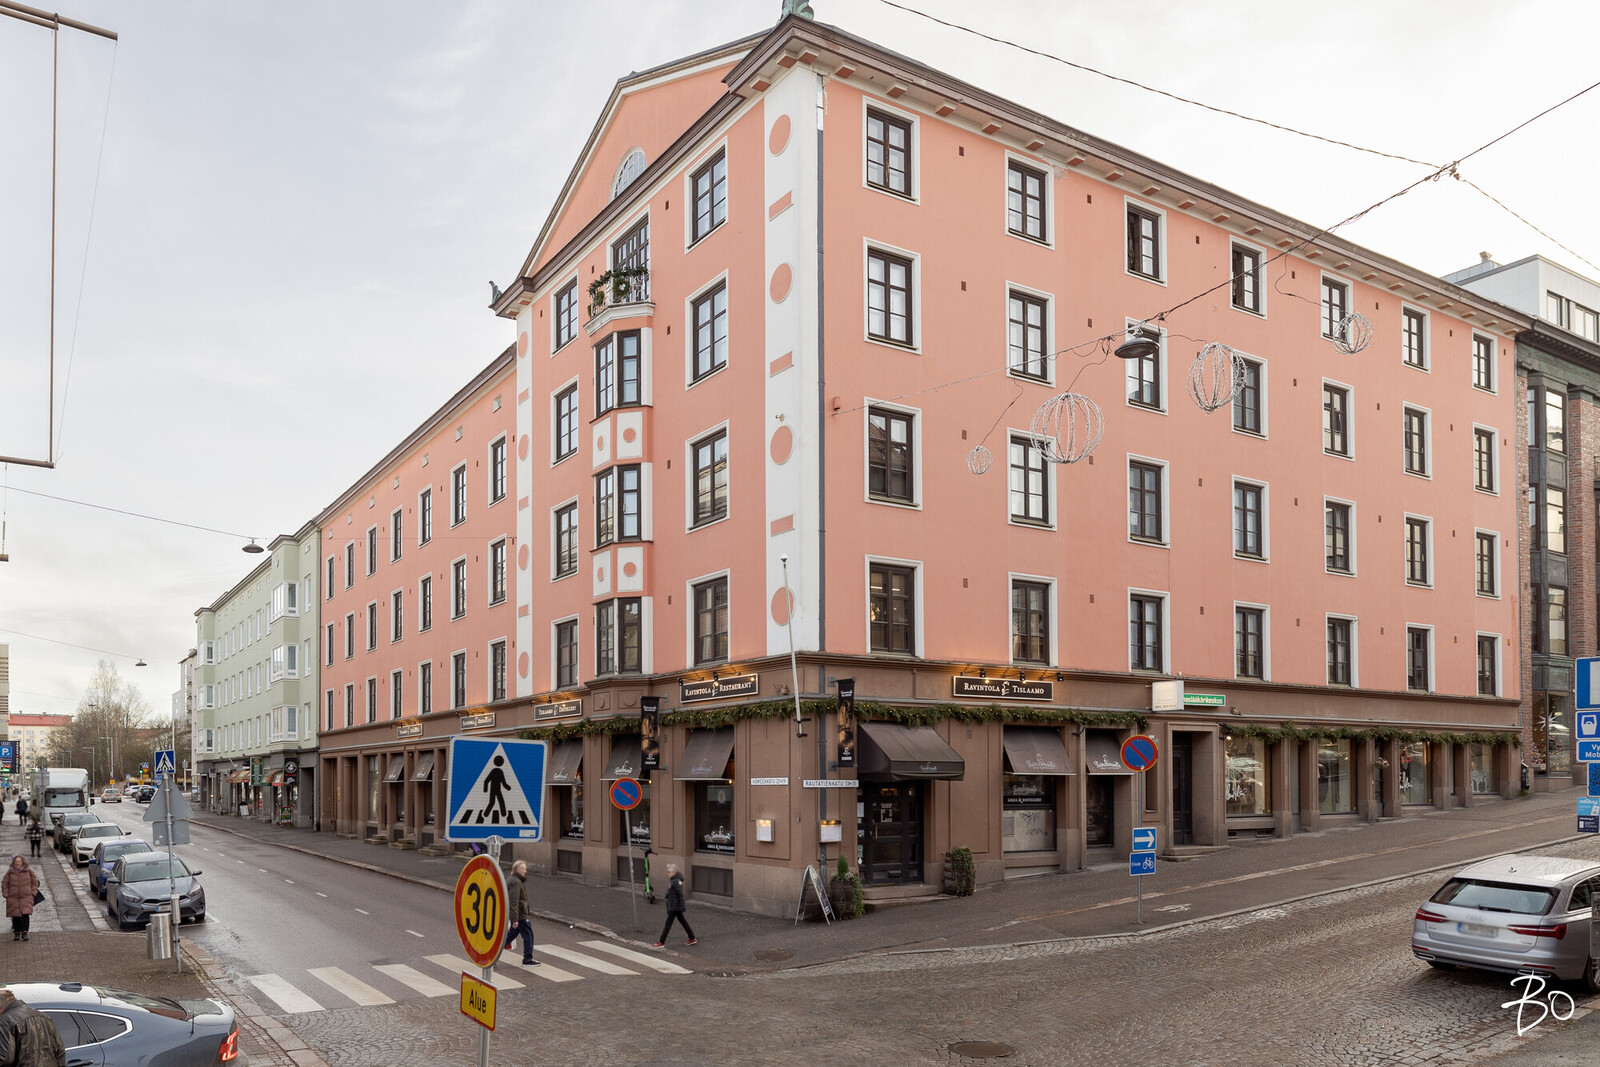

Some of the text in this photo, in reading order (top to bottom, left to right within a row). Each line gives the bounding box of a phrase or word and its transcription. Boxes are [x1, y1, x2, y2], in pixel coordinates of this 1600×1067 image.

[964, 682, 1000, 692] RAVINTOLA
[1012, 685, 1044, 695] TISLAAMO
[465, 883, 496, 941] 30
[469, 989, 487, 1014] Alue
